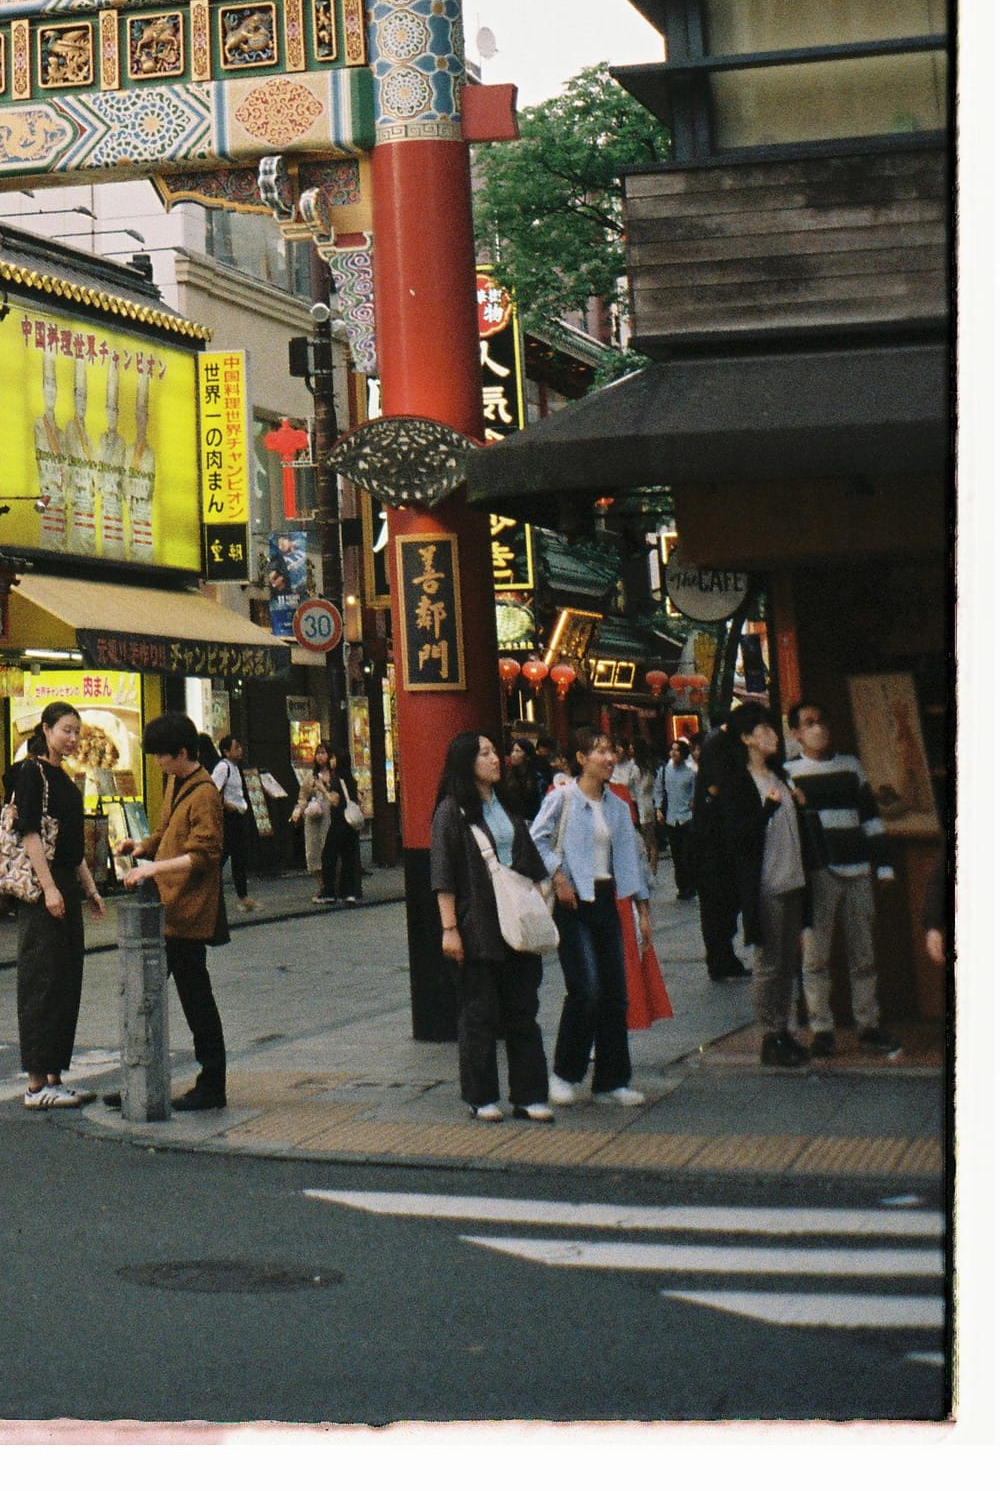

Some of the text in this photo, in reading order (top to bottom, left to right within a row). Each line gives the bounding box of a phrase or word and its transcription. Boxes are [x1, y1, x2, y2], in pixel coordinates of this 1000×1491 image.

[21, 314, 167, 380] 中国料理世界チャンピオン
[204, 363, 224, 513] 世界一の肉まん
[223, 356, 244, 519] 中国料理世界チャンピオン
[304, 615, 331, 638] 30
[83, 676, 112, 698] 肉まん
